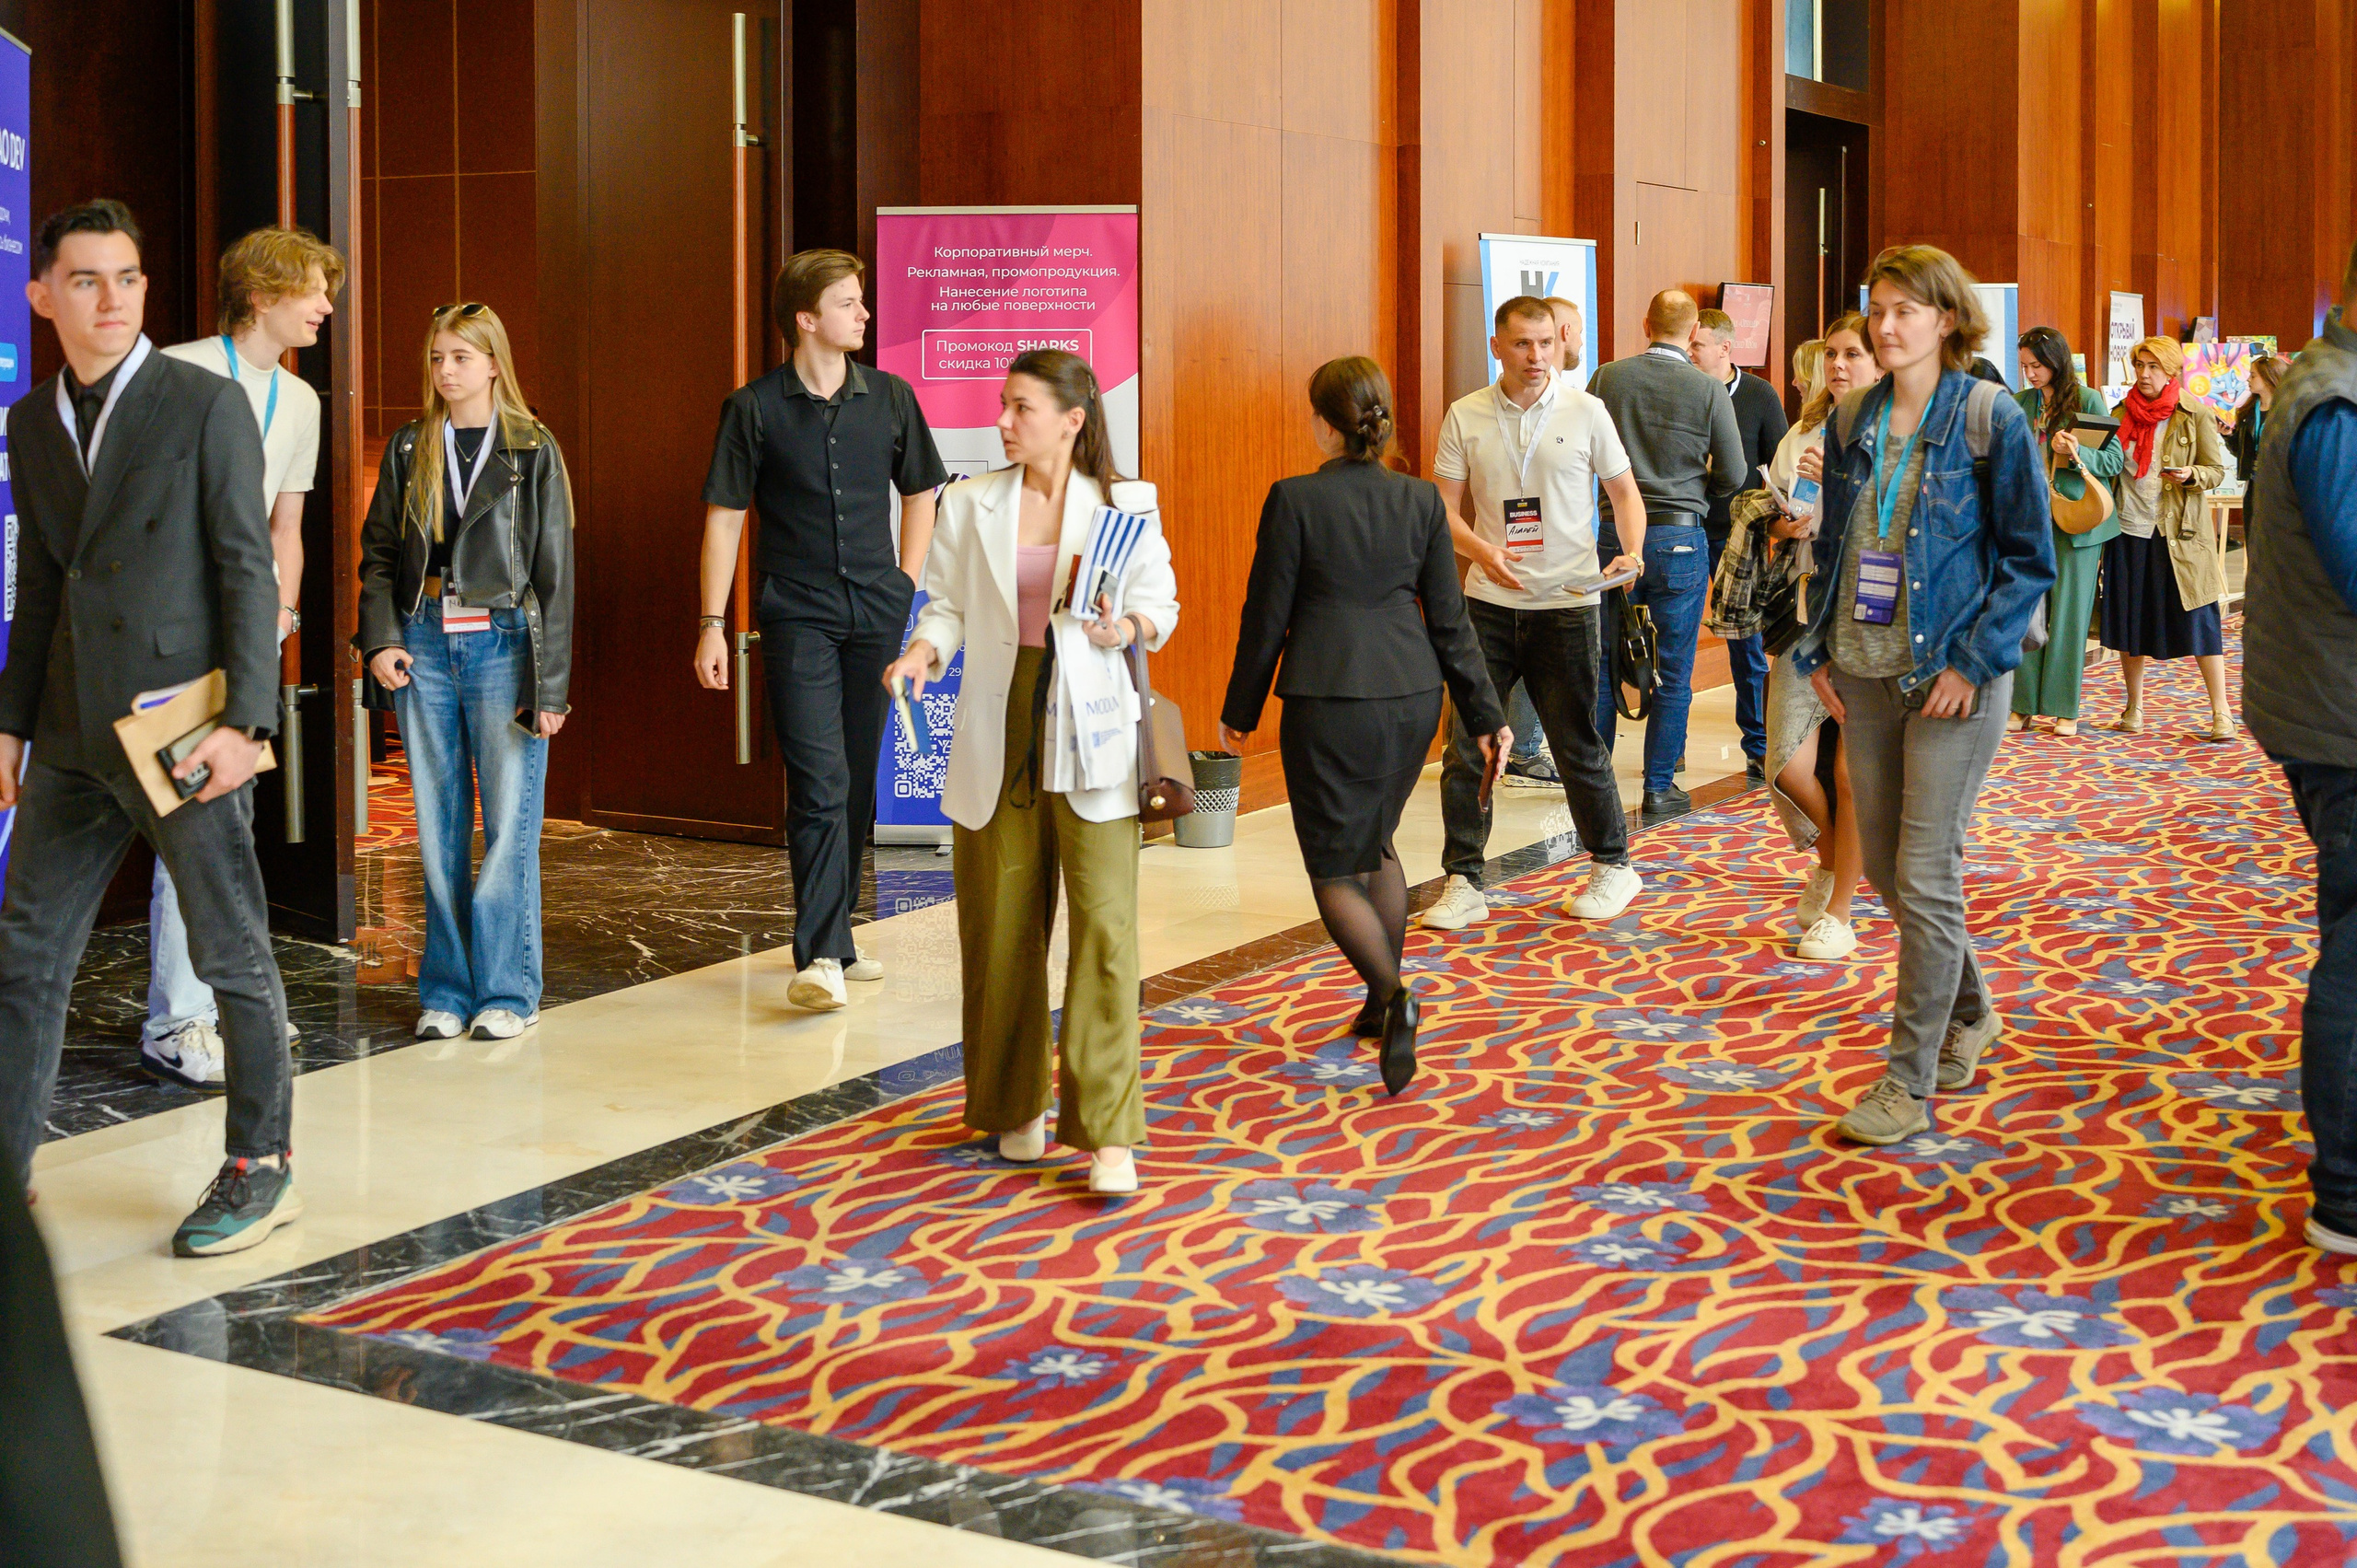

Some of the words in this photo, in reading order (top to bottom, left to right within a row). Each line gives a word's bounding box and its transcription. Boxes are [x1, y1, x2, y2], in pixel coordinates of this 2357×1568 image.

[9, 132, 26, 171] DEV
[934, 245, 1050, 260] Корпоративный
[1053, 248, 1093, 260] мерч.
[907, 266, 989, 280] Рекламная,
[992, 267, 1120, 280] промопродукция.
[939, 286, 1019, 297] Нанесение
[1022, 287, 1087, 297] логотипа
[931, 302, 948, 311] на
[951, 299, 1000, 311] любые
[1004, 301, 1096, 313] поверхности
[936, 340, 1014, 354] Промокод
[1016, 340, 1080, 352] SHARKS
[938, 357, 991, 370] скидка
[1509, 510, 1538, 518] BUSINESS
[948, 667, 962, 677] 29
